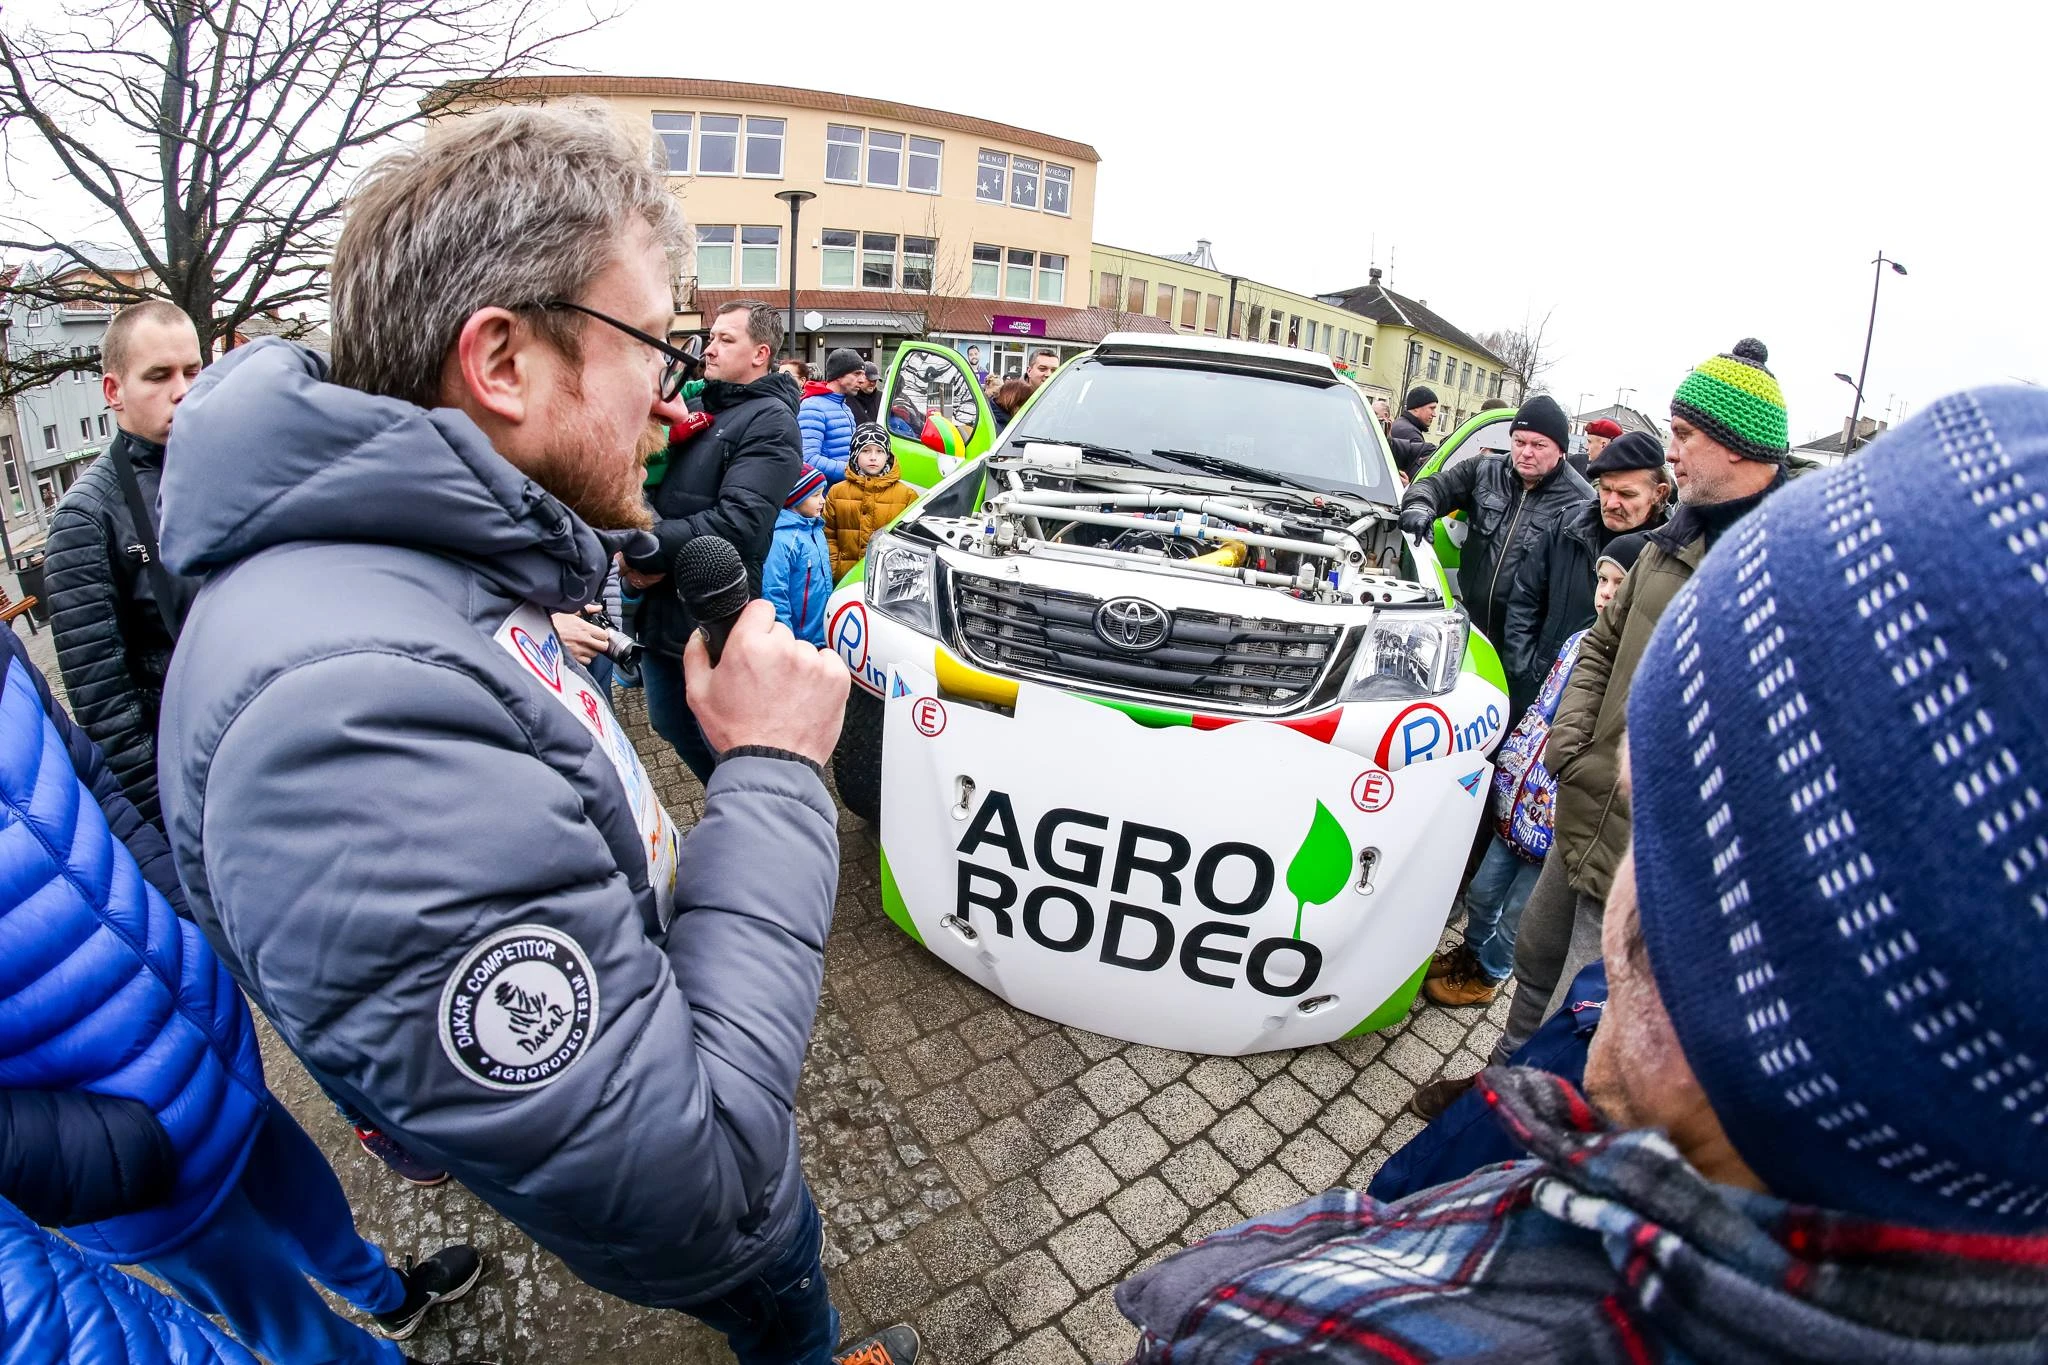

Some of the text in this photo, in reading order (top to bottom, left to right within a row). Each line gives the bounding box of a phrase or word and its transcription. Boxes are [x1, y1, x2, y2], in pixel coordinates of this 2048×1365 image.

[979, 154, 1003, 164] MENO
[921, 705, 937, 729] E
[1362, 780, 1383, 804] E
[956, 789, 1275, 916] AGRO
[957, 859, 1322, 997] RODEO
[453, 940, 556, 1048] DAKAR COMPETITOR
[489, 973, 589, 1082] AGRORODEO TEAM
[517, 1004, 572, 1055] DAKAR
